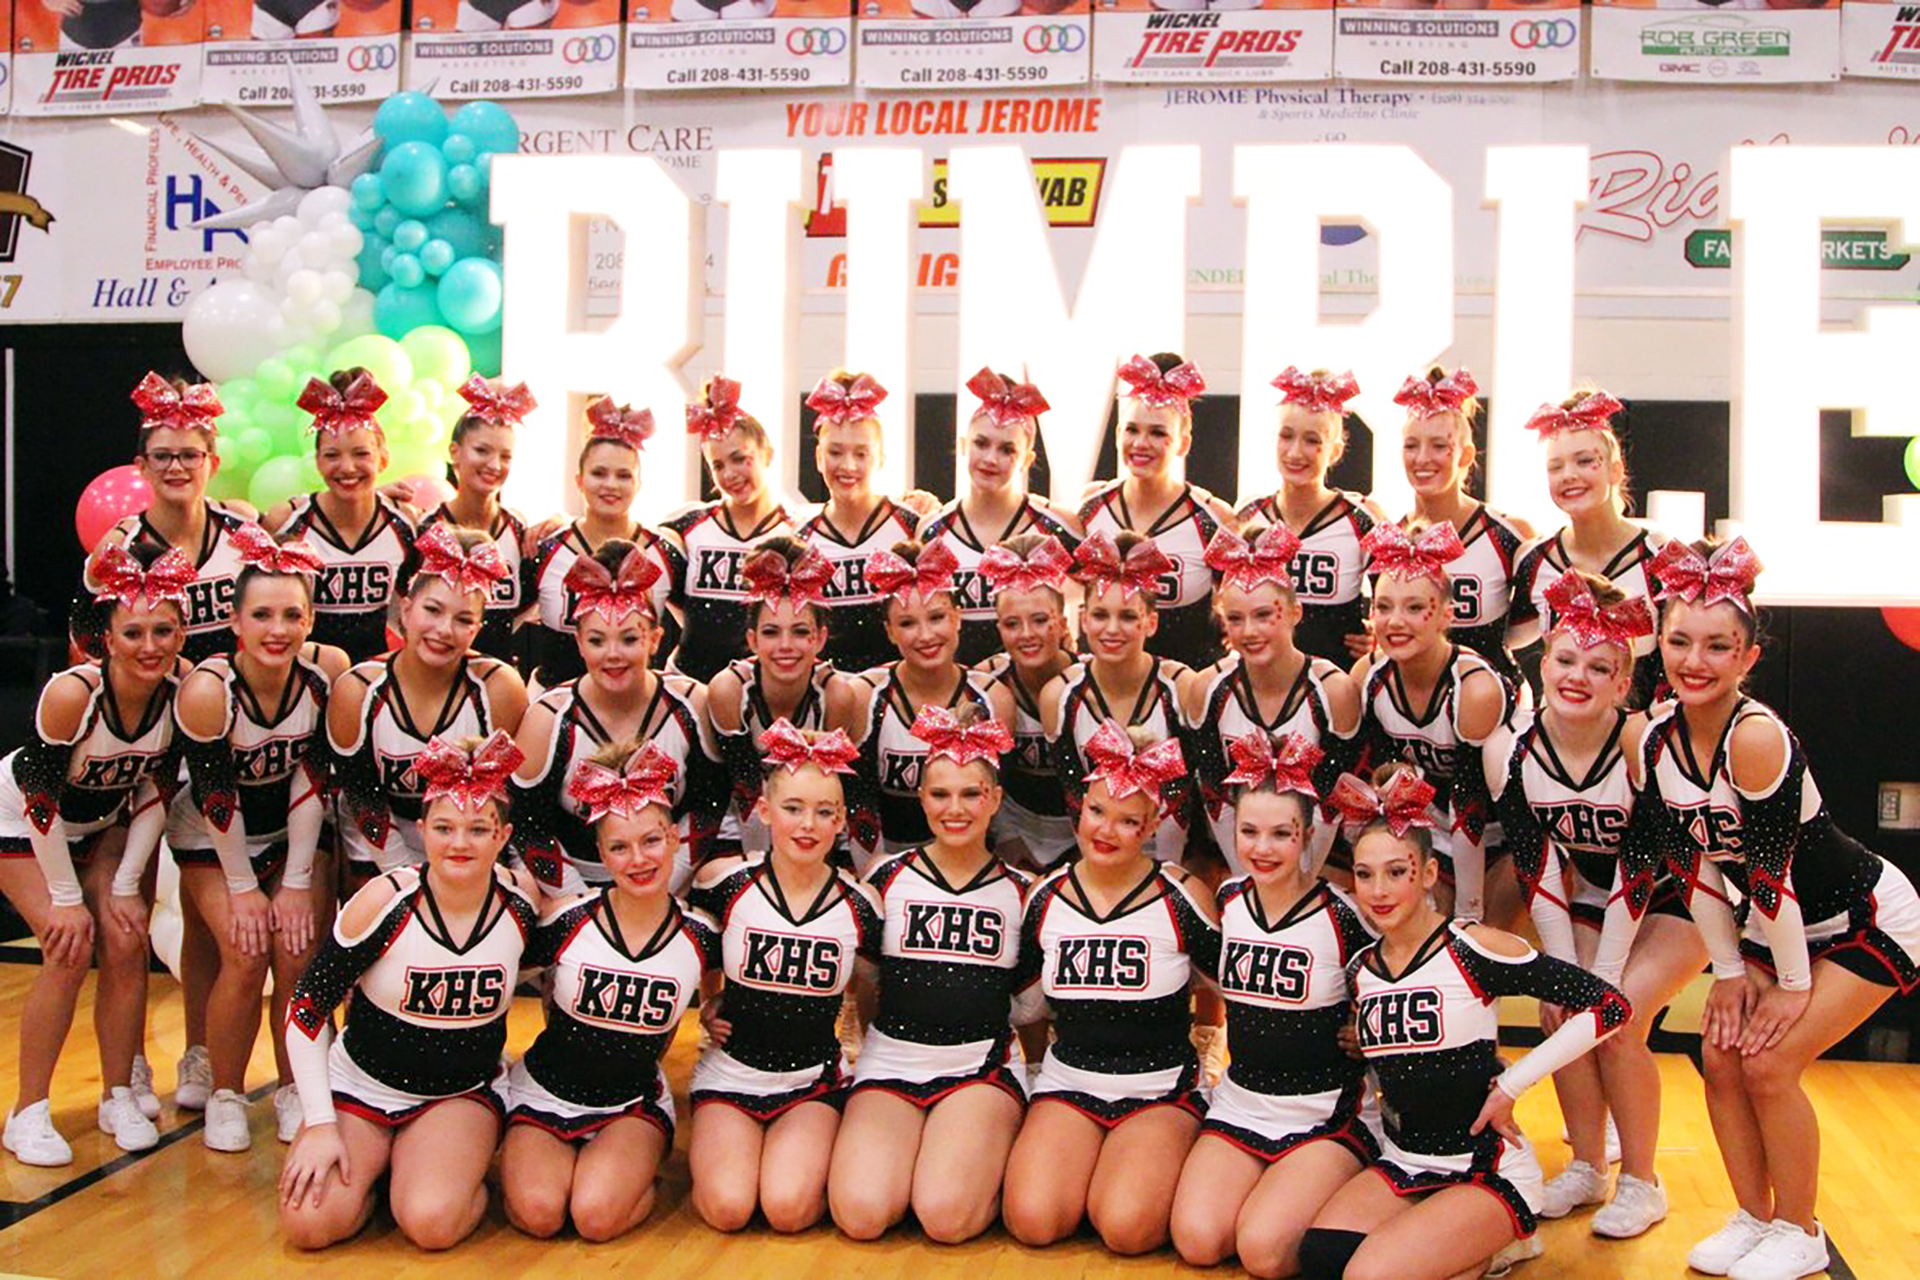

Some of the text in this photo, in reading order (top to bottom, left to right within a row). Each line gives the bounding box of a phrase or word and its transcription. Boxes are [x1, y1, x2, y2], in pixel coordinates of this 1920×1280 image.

[1146, 13, 1222, 29] WICKEL
[1343, 20, 1497, 36] WINNING SOLUTIONS
[634, 29, 773, 46] WINNING SOLUTIONS
[865, 28, 1010, 44] WINNING SOLUTIONS
[1640, 30, 1790, 46] ROB GREEN
[210, 52, 266, 64] WINNING
[419, 40, 551, 56] WINNING SOLUTIONS
[1131, 29, 1303, 68] TIRE PROS
[55, 51, 115, 68] WICKEL
[1380, 60, 1536, 76] Call 208-431-5590
[44, 63, 181, 104] TIRE PROS
[450, 76, 583, 93] Call 208-431-5590
[667, 68, 810, 83] Call 208-431-5590
[901, 66, 1048, 83] Call 208-431-5590
[239, 86, 267, 100] Call
[1164, 88, 1248, 108] JEROME
[1255, 88, 1329, 108] Physical
[1335, 87, 1414, 107] Therapy
[785, 98, 1103, 137] YOUR LOCAL JEROME
[1271, 107, 1313, 124] Sports
[1317, 107, 1377, 120] Medicine
[1381, 107, 1420, 120] Clinic
[519, 123, 714, 154] RGENT CARE
[1821, 240, 1893, 259] RKETS
[145, 258, 214, 271] EMPLOYEE
[92, 276, 191, 308] Hall &
[700, 550, 751, 590] KH
[1286, 552, 1336, 596] HS
[313, 564, 389, 605] KHS
[184, 578, 236, 627] HS
[904, 904, 1004, 956] KHS
[743, 932, 841, 990] KHS
[1054, 938, 1148, 987] KHS
[1220, 942, 1312, 1002] KHS
[403, 969, 505, 1017] KHS
[577, 968, 678, 1027] KHS
[1358, 990, 1443, 1050] KHS
